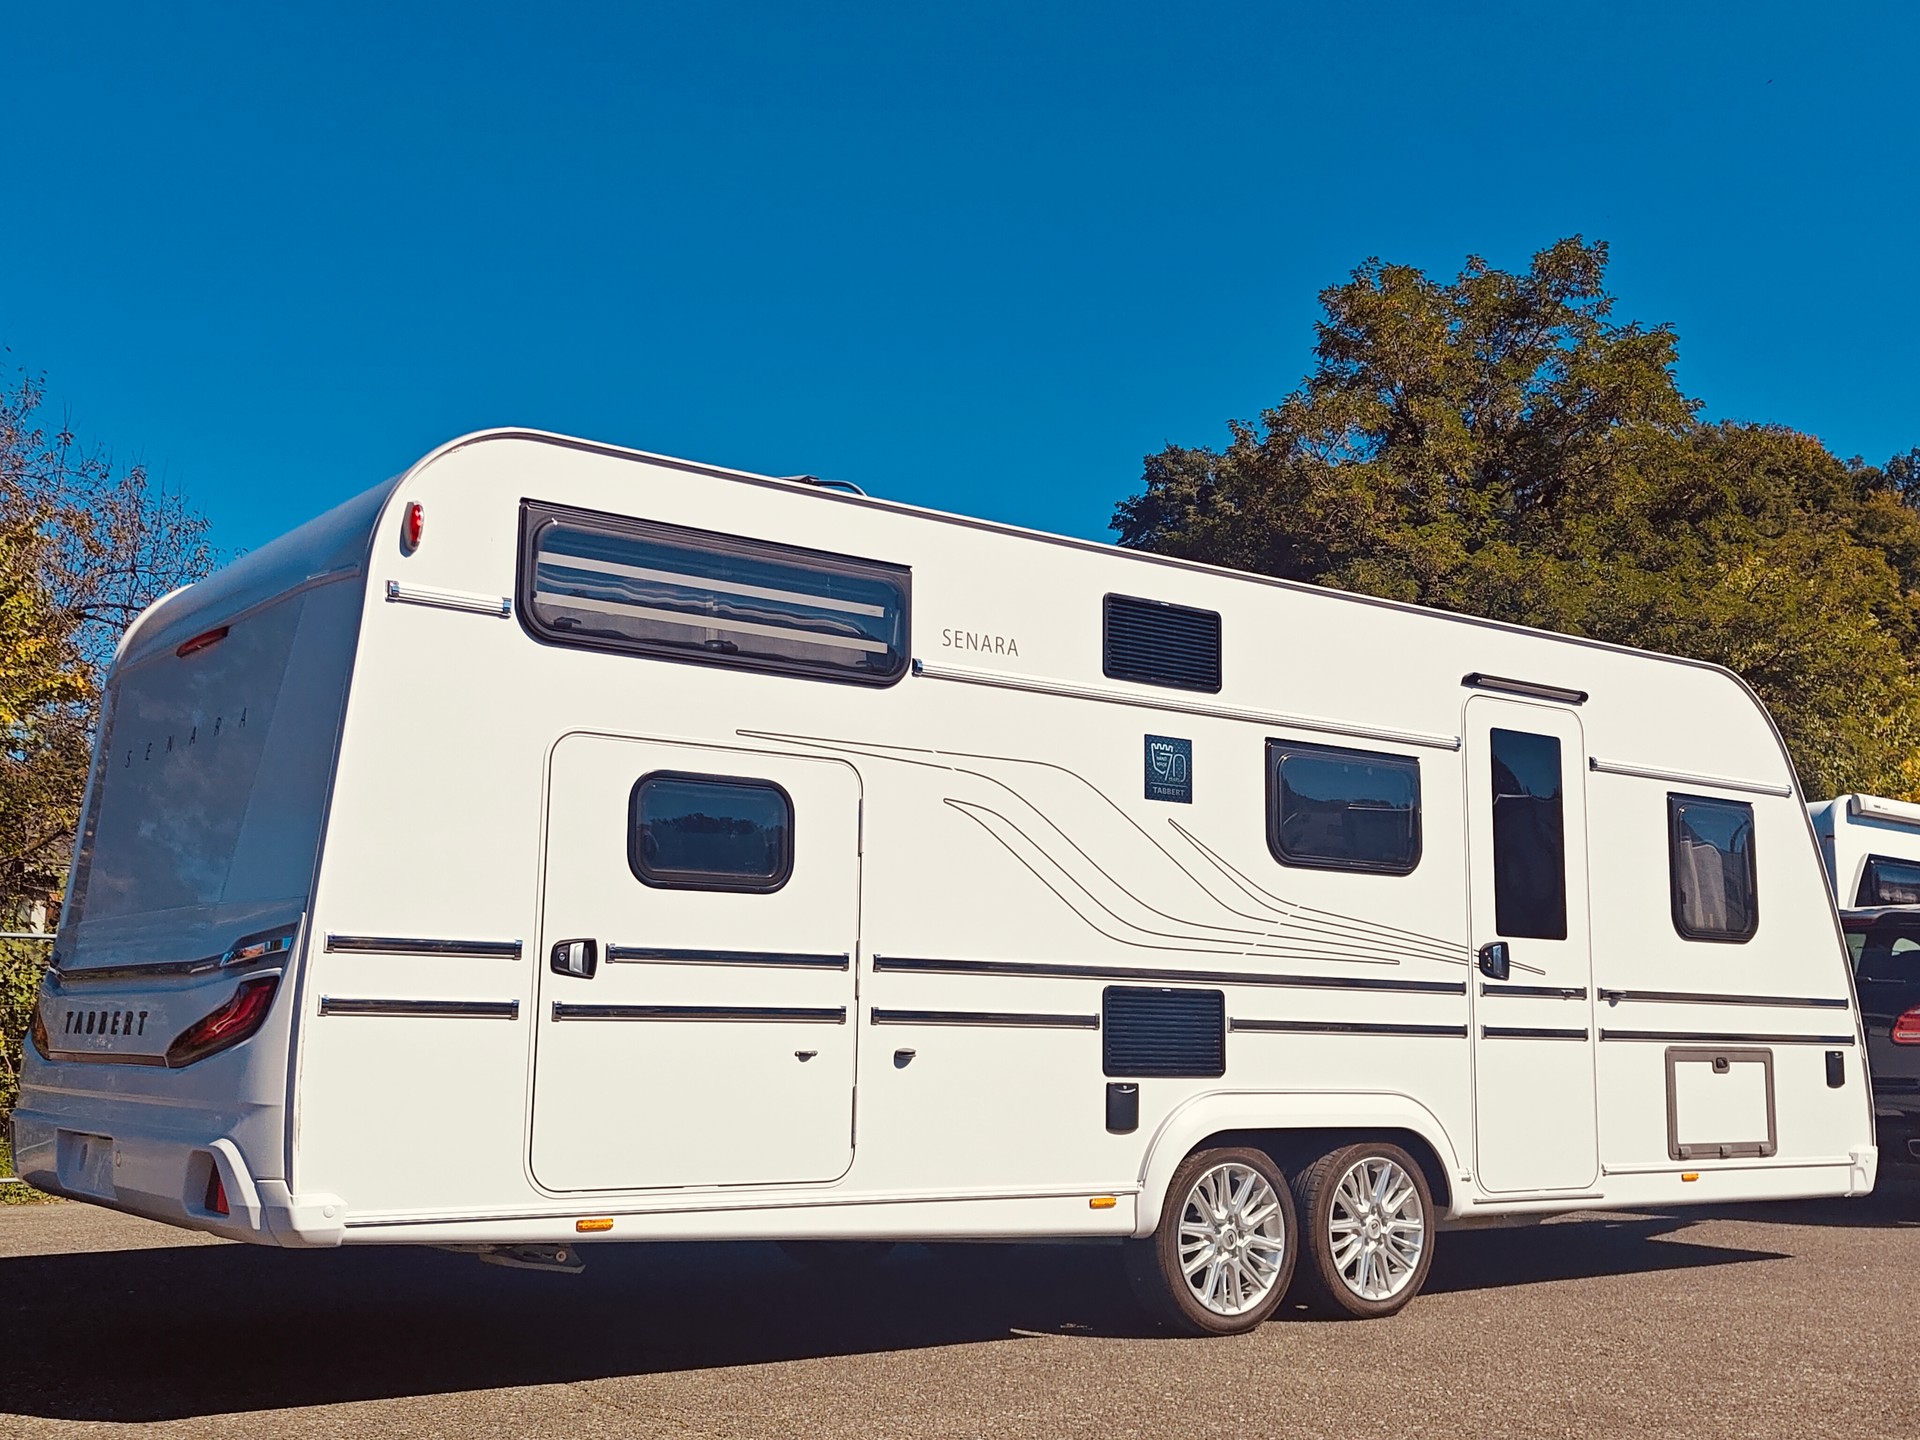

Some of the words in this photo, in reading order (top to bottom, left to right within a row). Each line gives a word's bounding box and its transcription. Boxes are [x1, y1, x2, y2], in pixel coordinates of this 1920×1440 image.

[942, 628, 1019, 657] SENARA
[124, 707, 247, 769] SENARA
[1152, 786, 1186, 797] TABBERT
[65, 1011, 149, 1036] TABBERT
